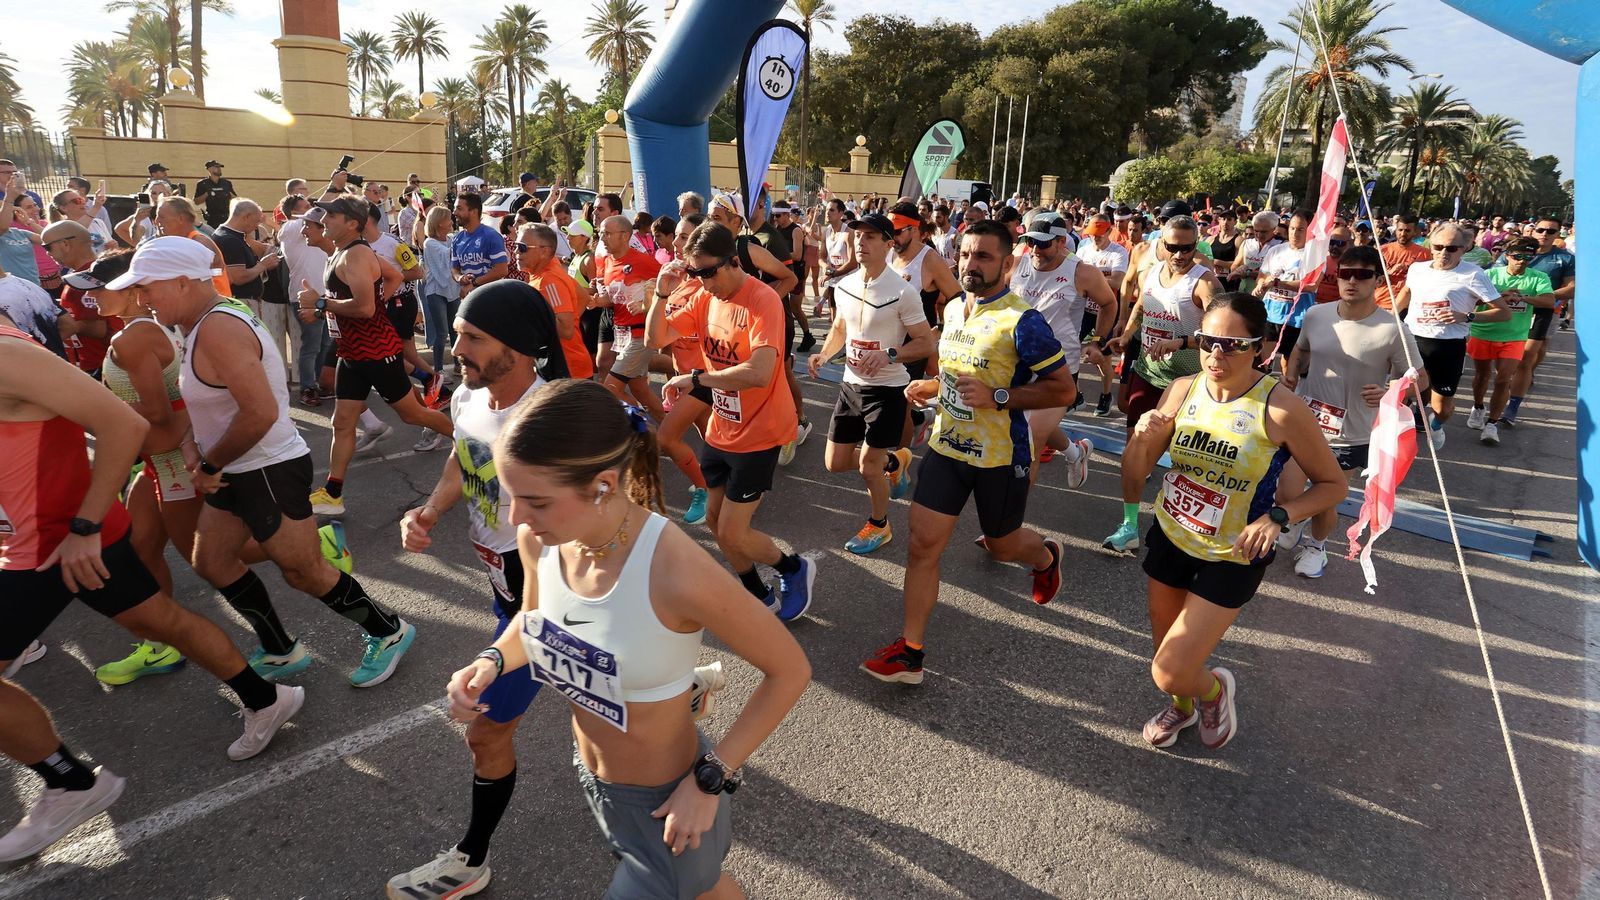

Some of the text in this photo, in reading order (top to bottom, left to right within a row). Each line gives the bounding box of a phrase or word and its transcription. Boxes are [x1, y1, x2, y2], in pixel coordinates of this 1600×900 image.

[771, 62, 786, 78] 1h
[960, 352, 990, 370] CÁDIZ
[946, 387, 957, 404] 73
[1175, 430, 1239, 461] LaMafia
[1177, 450, 1199, 459] SIENTA
[1214, 460, 1234, 469] MESA
[1205, 472, 1251, 492] CÁDIZ
[1172, 490, 1206, 517] 357
[542, 648, 593, 689] 717
